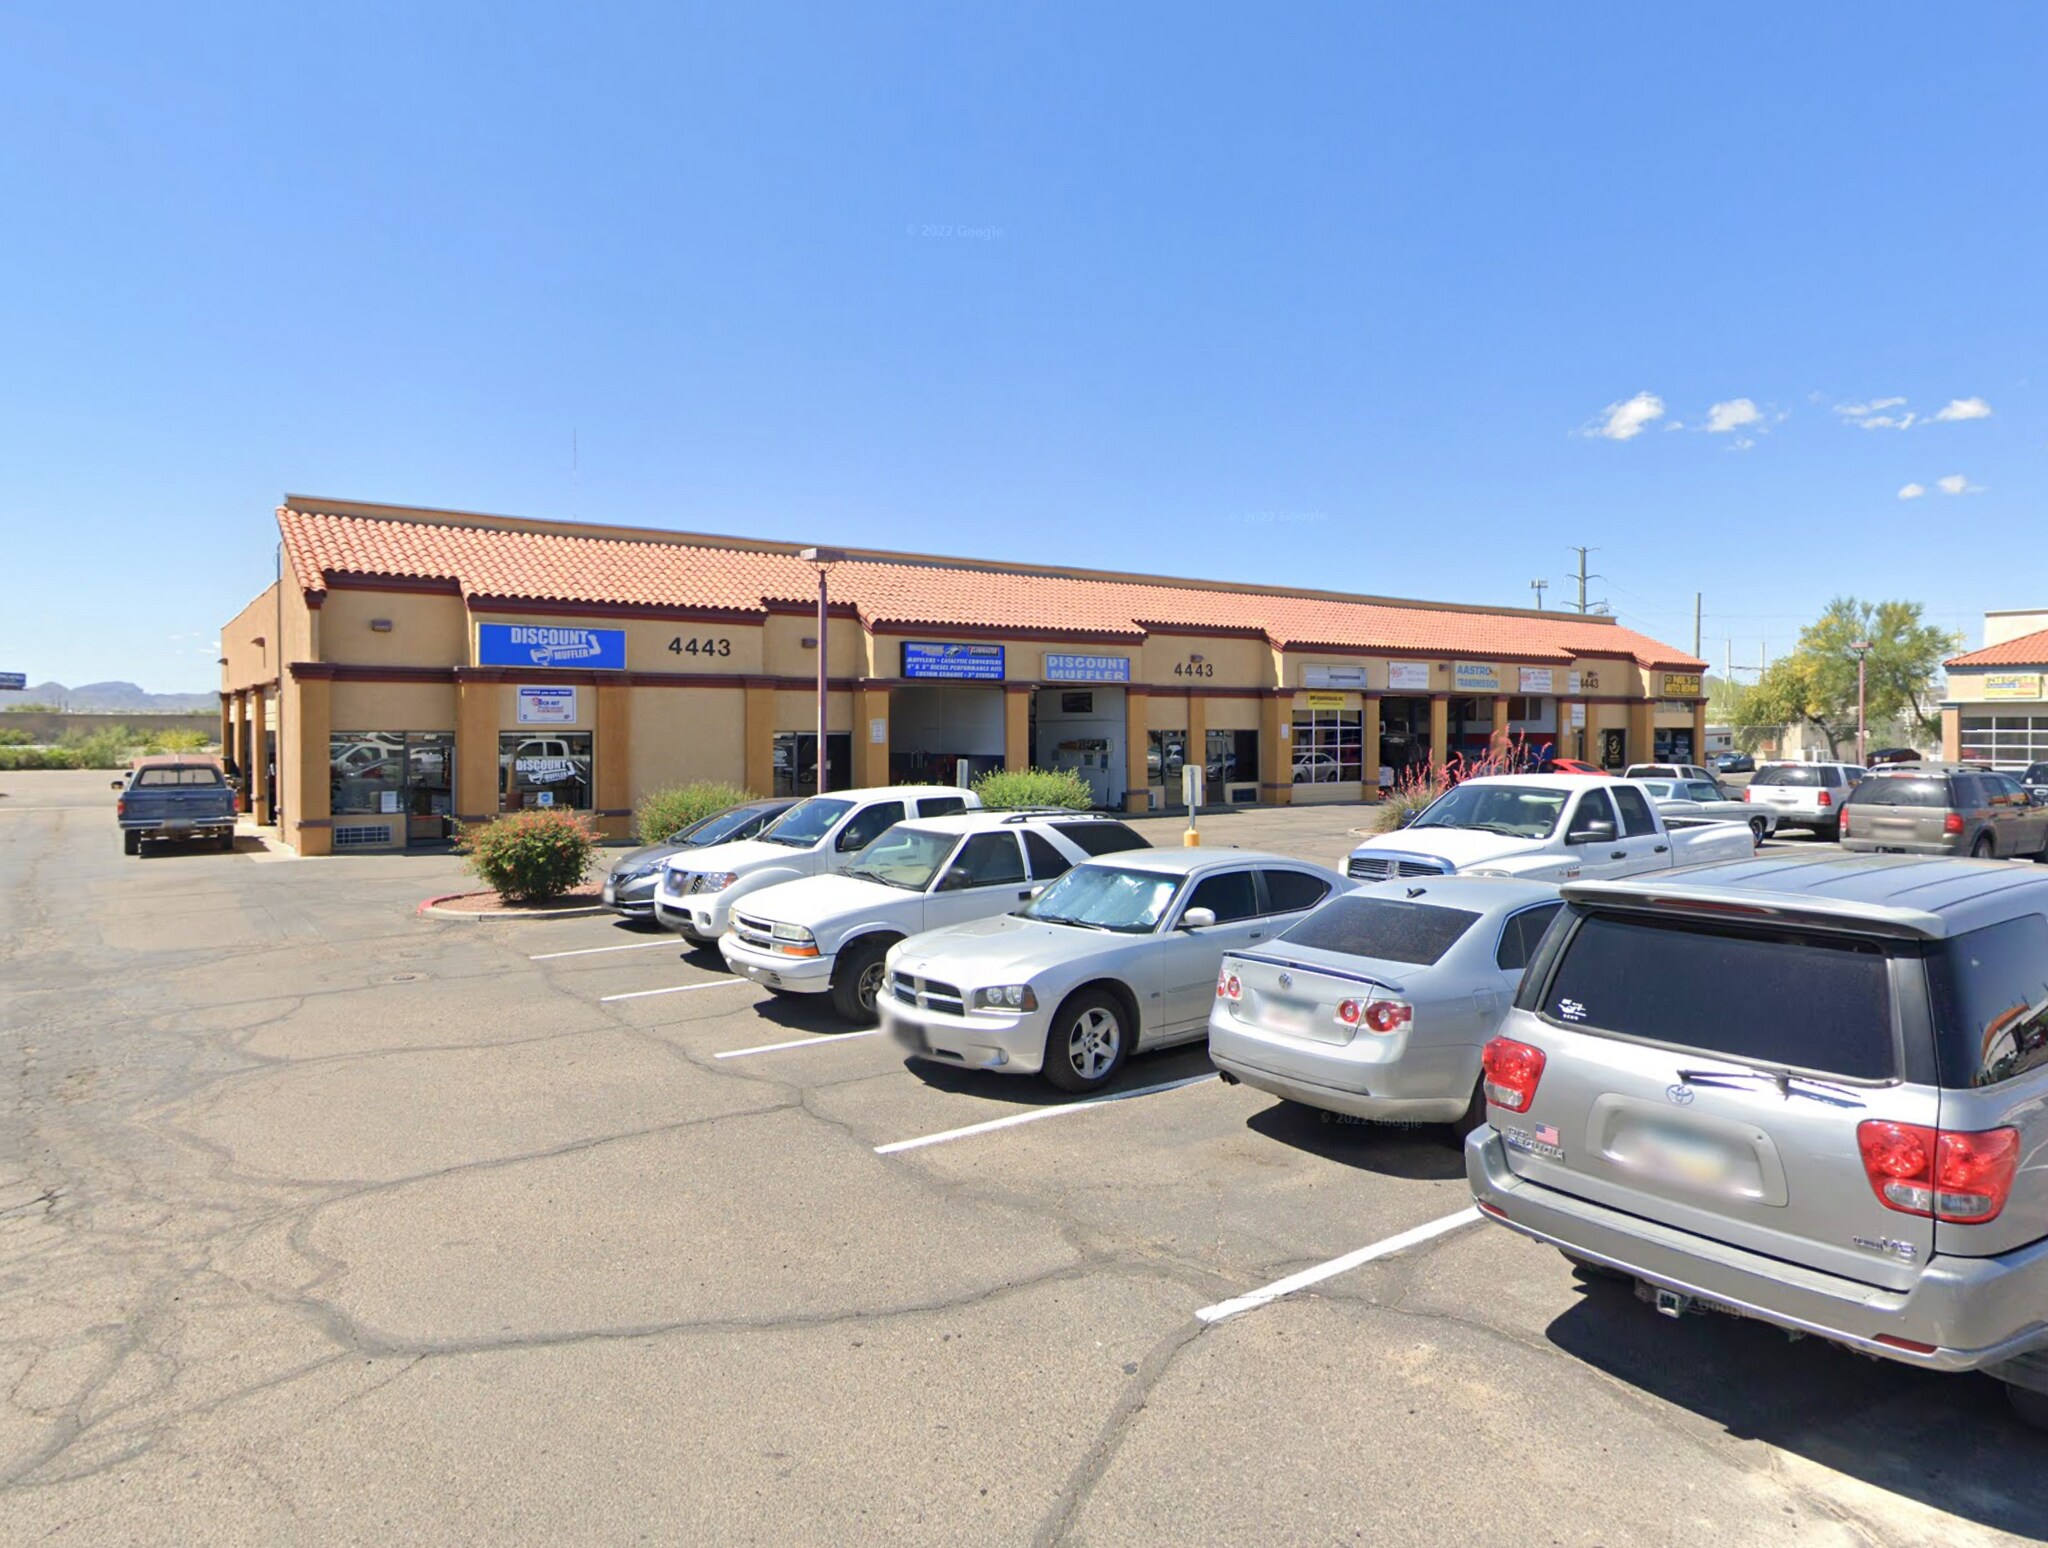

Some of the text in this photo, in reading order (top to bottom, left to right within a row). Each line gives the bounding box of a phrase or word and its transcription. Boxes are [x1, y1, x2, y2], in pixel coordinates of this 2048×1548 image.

[511, 627, 588, 645] DISCOUNT
[668, 637, 731, 657] 4443
[554, 649, 589, 660] MUFFLER
[1048, 656, 1126, 670] DISCOUNT
[1051, 669, 1125, 680] MUFFLER
[1174, 663, 1214, 677] 4443
[1457, 678, 1499, 689] TRANSMISSION
[516, 759, 567, 771] DISCOUNT
